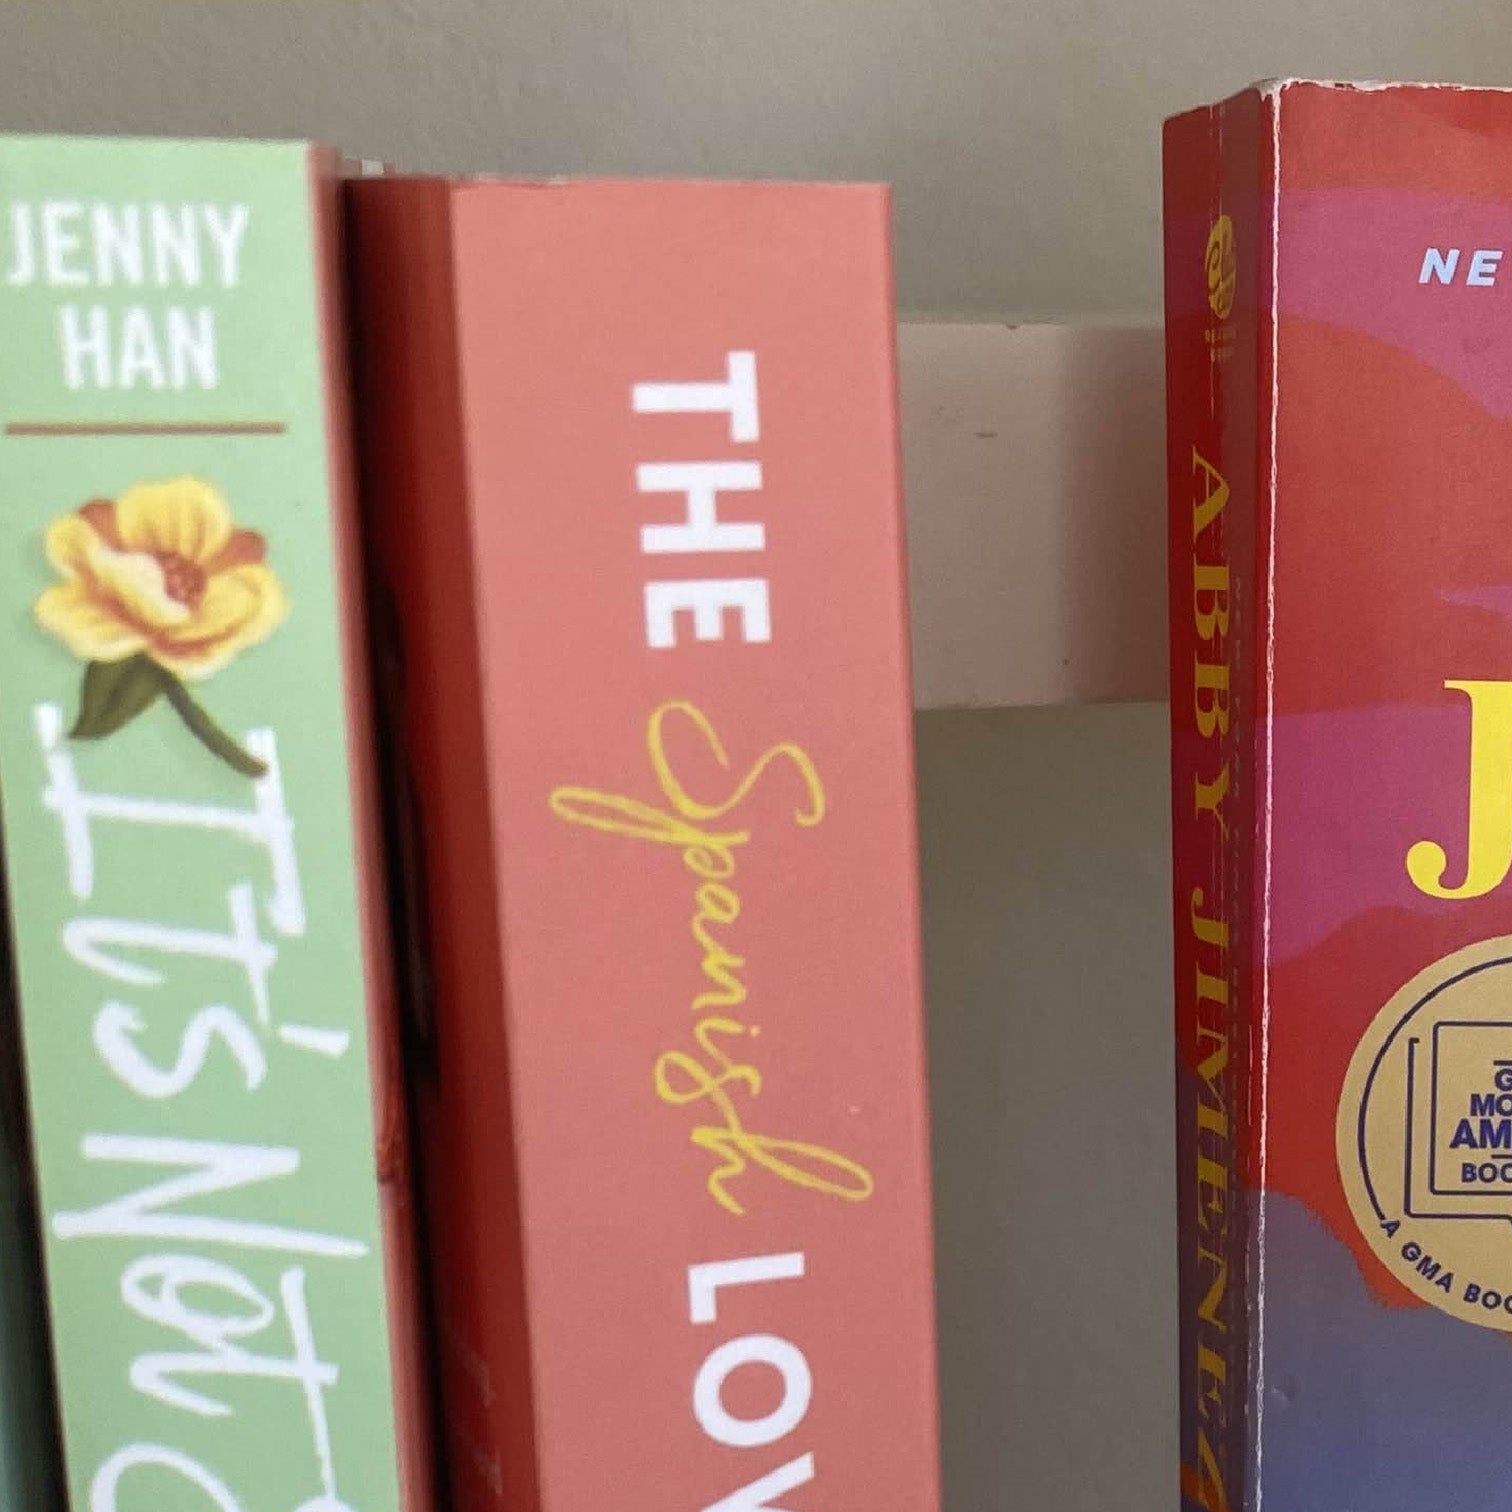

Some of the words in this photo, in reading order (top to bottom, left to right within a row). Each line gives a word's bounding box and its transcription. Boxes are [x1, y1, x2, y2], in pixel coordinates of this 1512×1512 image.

[5, 197, 250, 290] JENNY
[59, 304, 221, 391] HAN
[631, 350, 772, 649] THE
[1191, 444, 1231, 842] ABBY
[549, 700, 873, 1217] Spanish
[51, 1132, 369, 1492] Not
[1380, 1218, 1402, 1239] A
[1400, 1240, 1456, 1294] GMA
